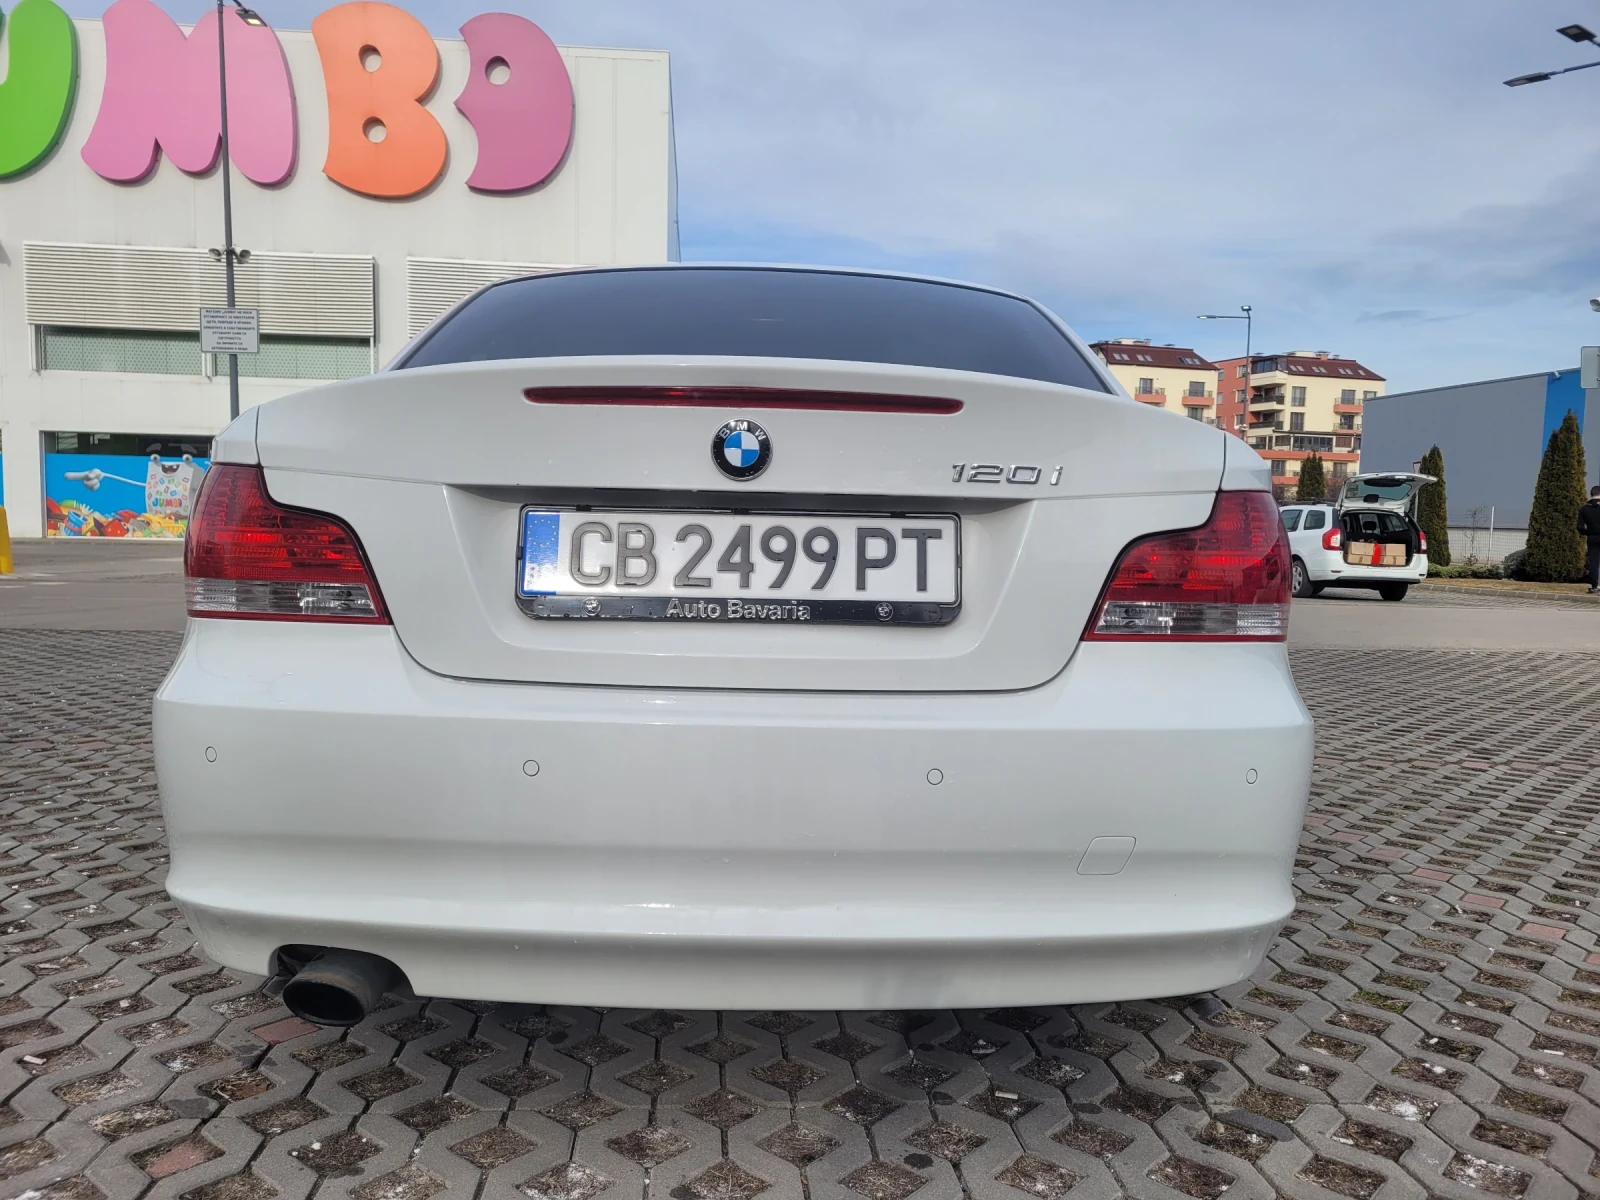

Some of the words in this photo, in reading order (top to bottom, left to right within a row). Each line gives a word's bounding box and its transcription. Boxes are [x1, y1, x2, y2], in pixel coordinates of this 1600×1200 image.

[719, 421, 767, 441] BMW
[152, 498, 182, 508] JUMBO
[569, 521, 657, 588] CB
[673, 523, 839, 590] 2499
[855, 526, 942, 592] PT
[665, 598, 721, 618] Auto
[726, 599, 811, 620] Bavaria
